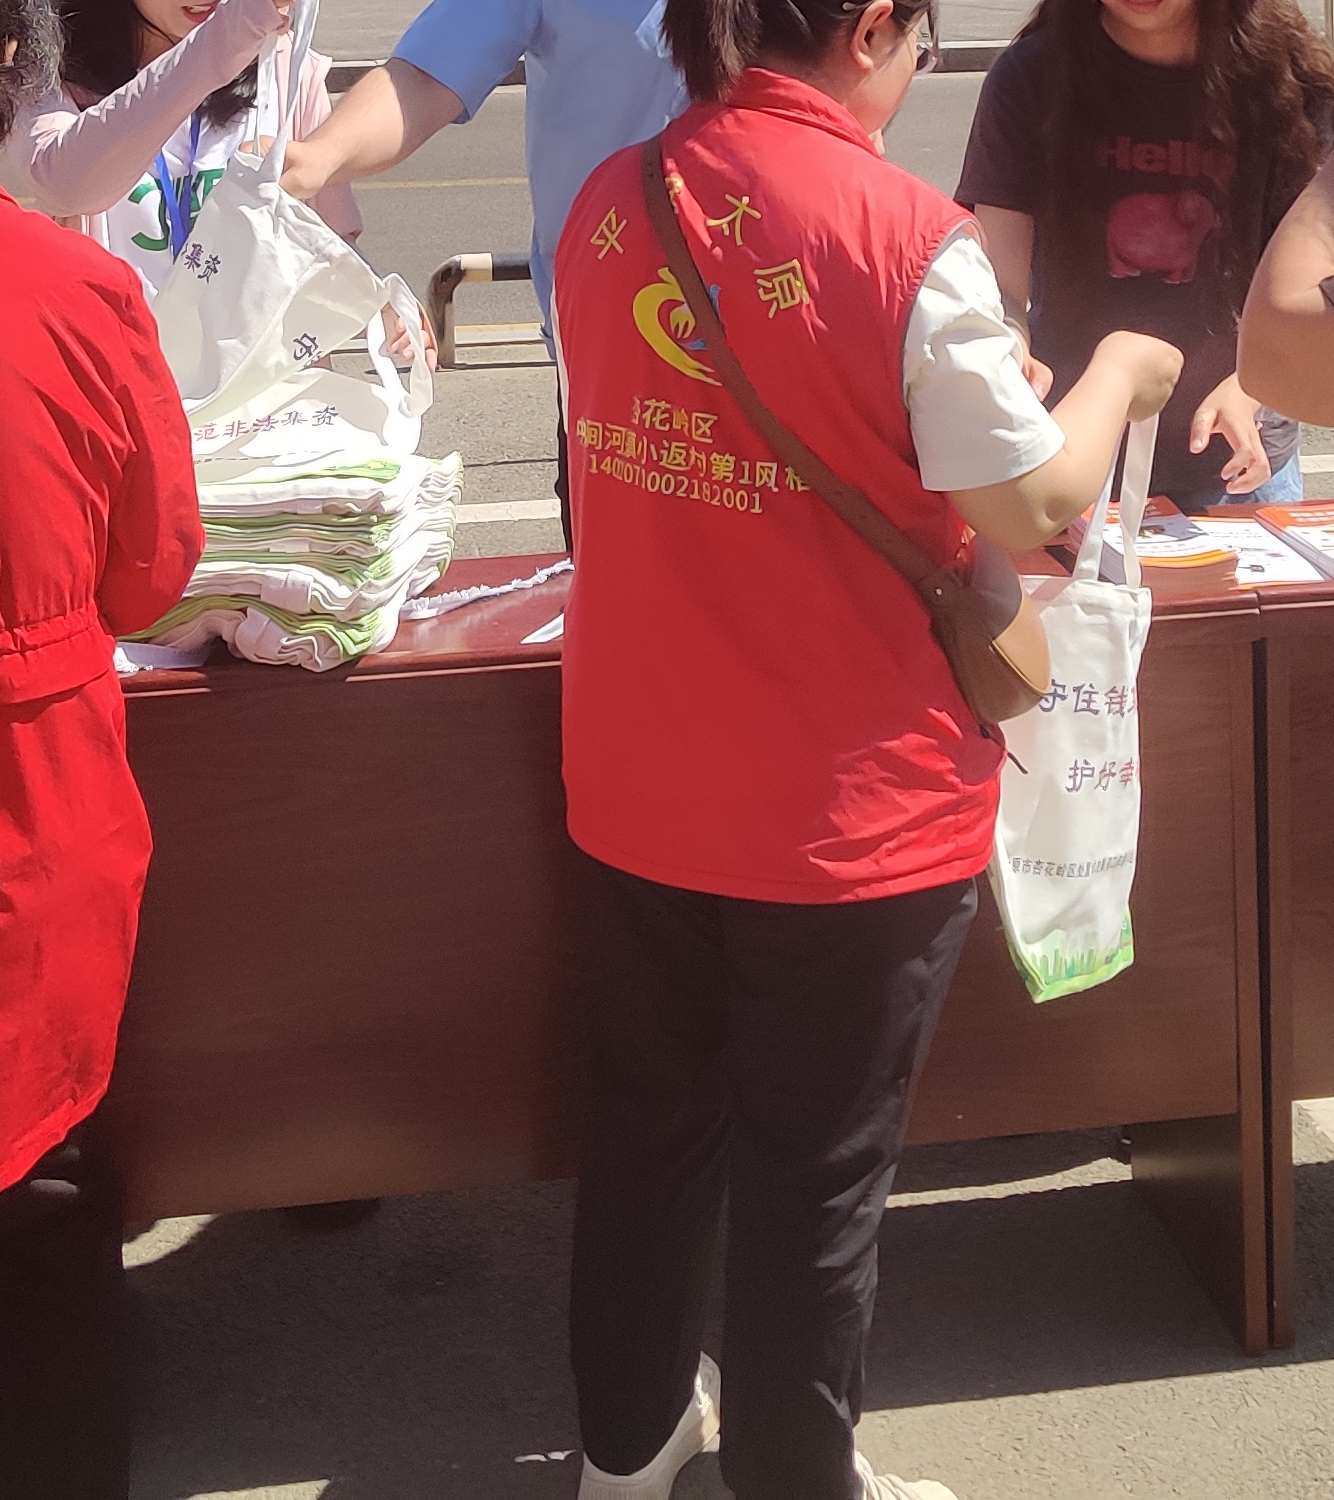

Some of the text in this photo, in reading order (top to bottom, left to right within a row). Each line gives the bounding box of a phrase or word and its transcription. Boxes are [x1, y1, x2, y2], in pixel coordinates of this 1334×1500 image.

[1095, 135, 1233, 180] Hell
[181, 243, 222, 285] 集资
[1039, 679, 1135, 718] 守住钱
[1065, 757, 1138, 793] 护好幸
